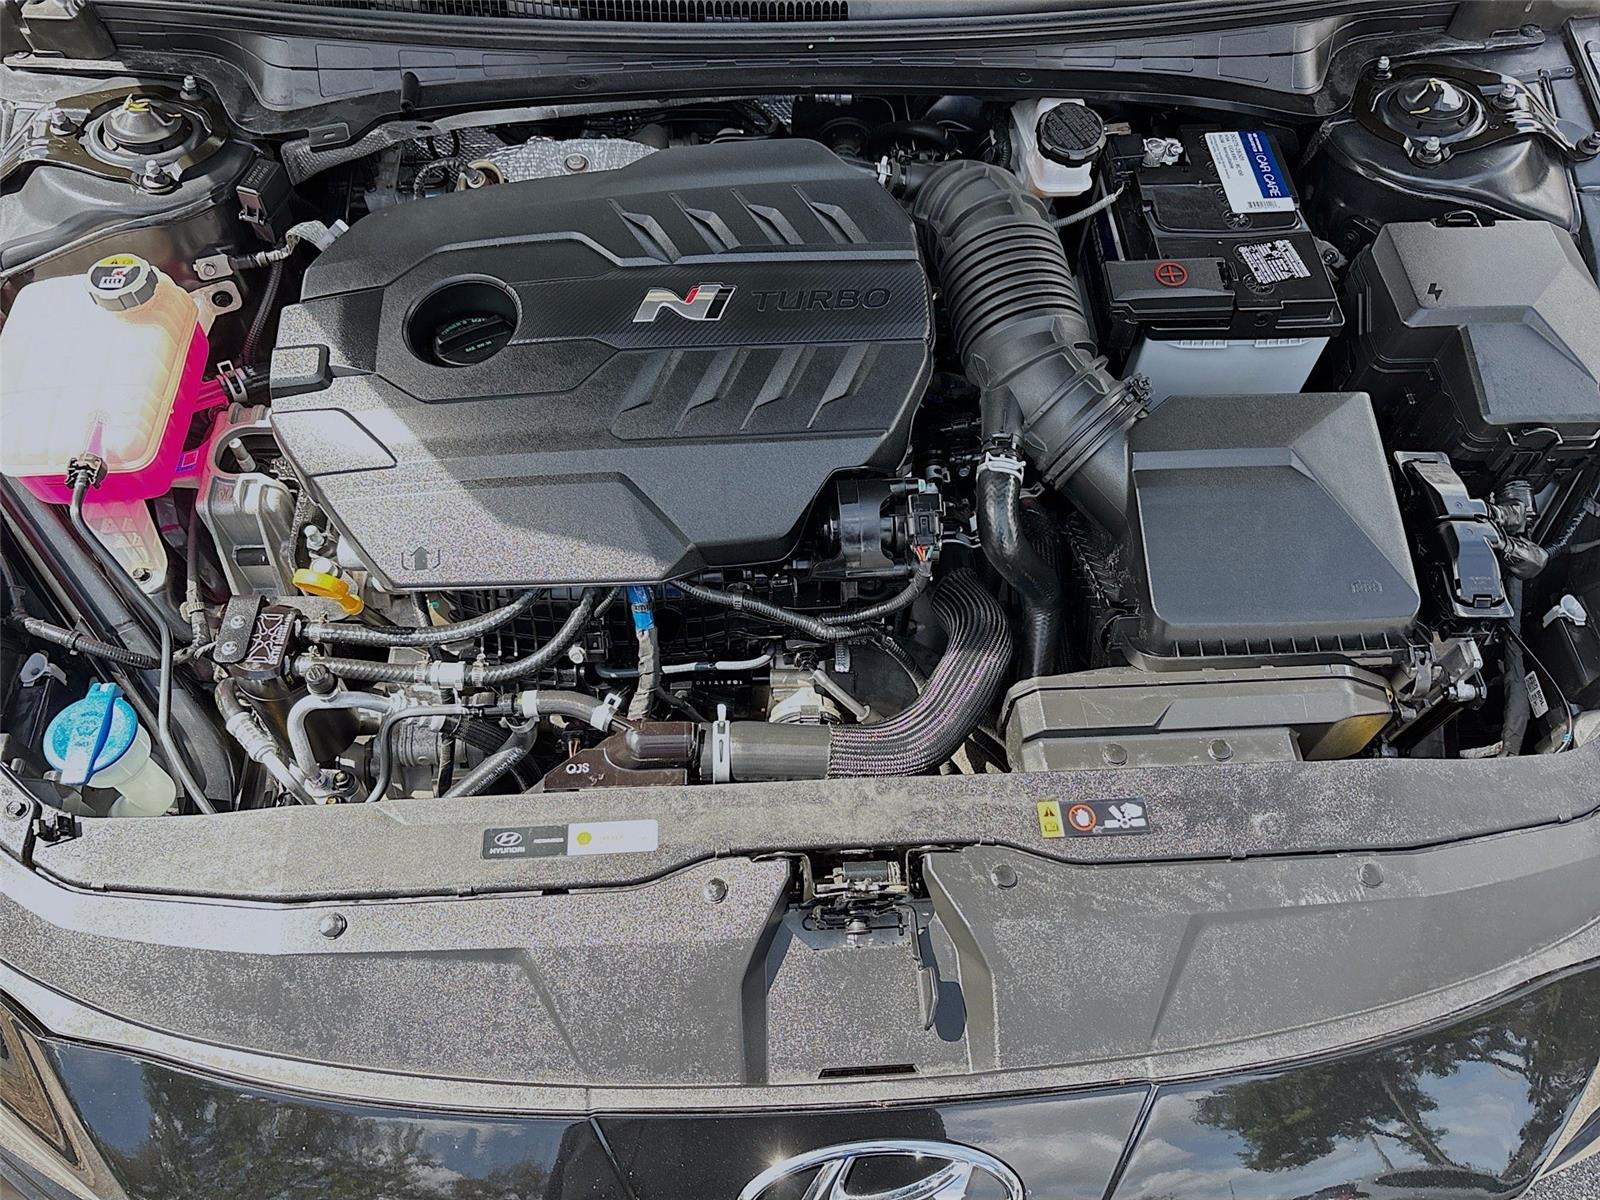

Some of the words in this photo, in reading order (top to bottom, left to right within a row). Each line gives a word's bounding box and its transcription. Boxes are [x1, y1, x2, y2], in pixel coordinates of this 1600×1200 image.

[1256, 155, 1271, 173] CAR
[1264, 174, 1281, 197] CARE
[751, 287, 893, 313] TURBO
[565, 762, 590, 775] QJS
[489, 846, 526, 855] HYUNDAI
